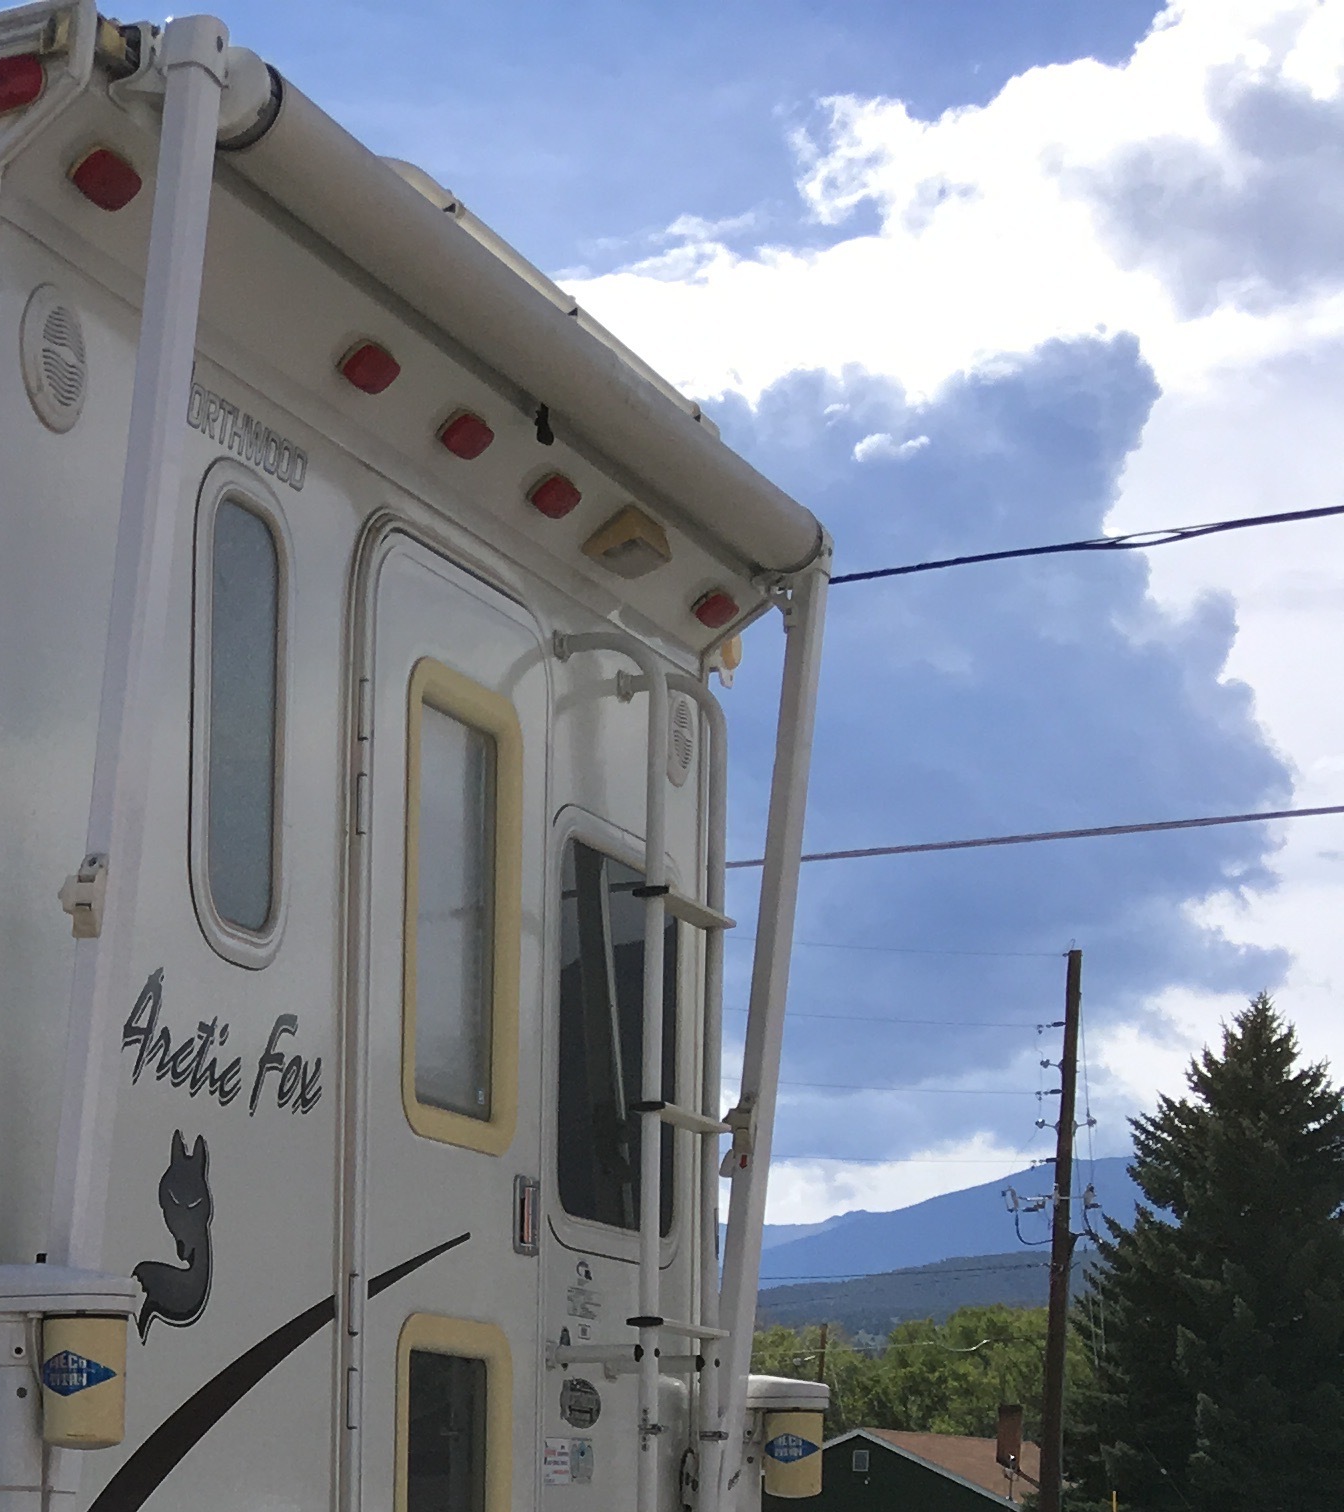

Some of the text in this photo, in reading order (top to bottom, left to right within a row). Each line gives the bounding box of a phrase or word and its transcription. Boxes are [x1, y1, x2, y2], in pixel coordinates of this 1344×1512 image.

[187, 364, 308, 492] ORTHWOOD
[121, 967, 322, 1118] Arctic Fox
